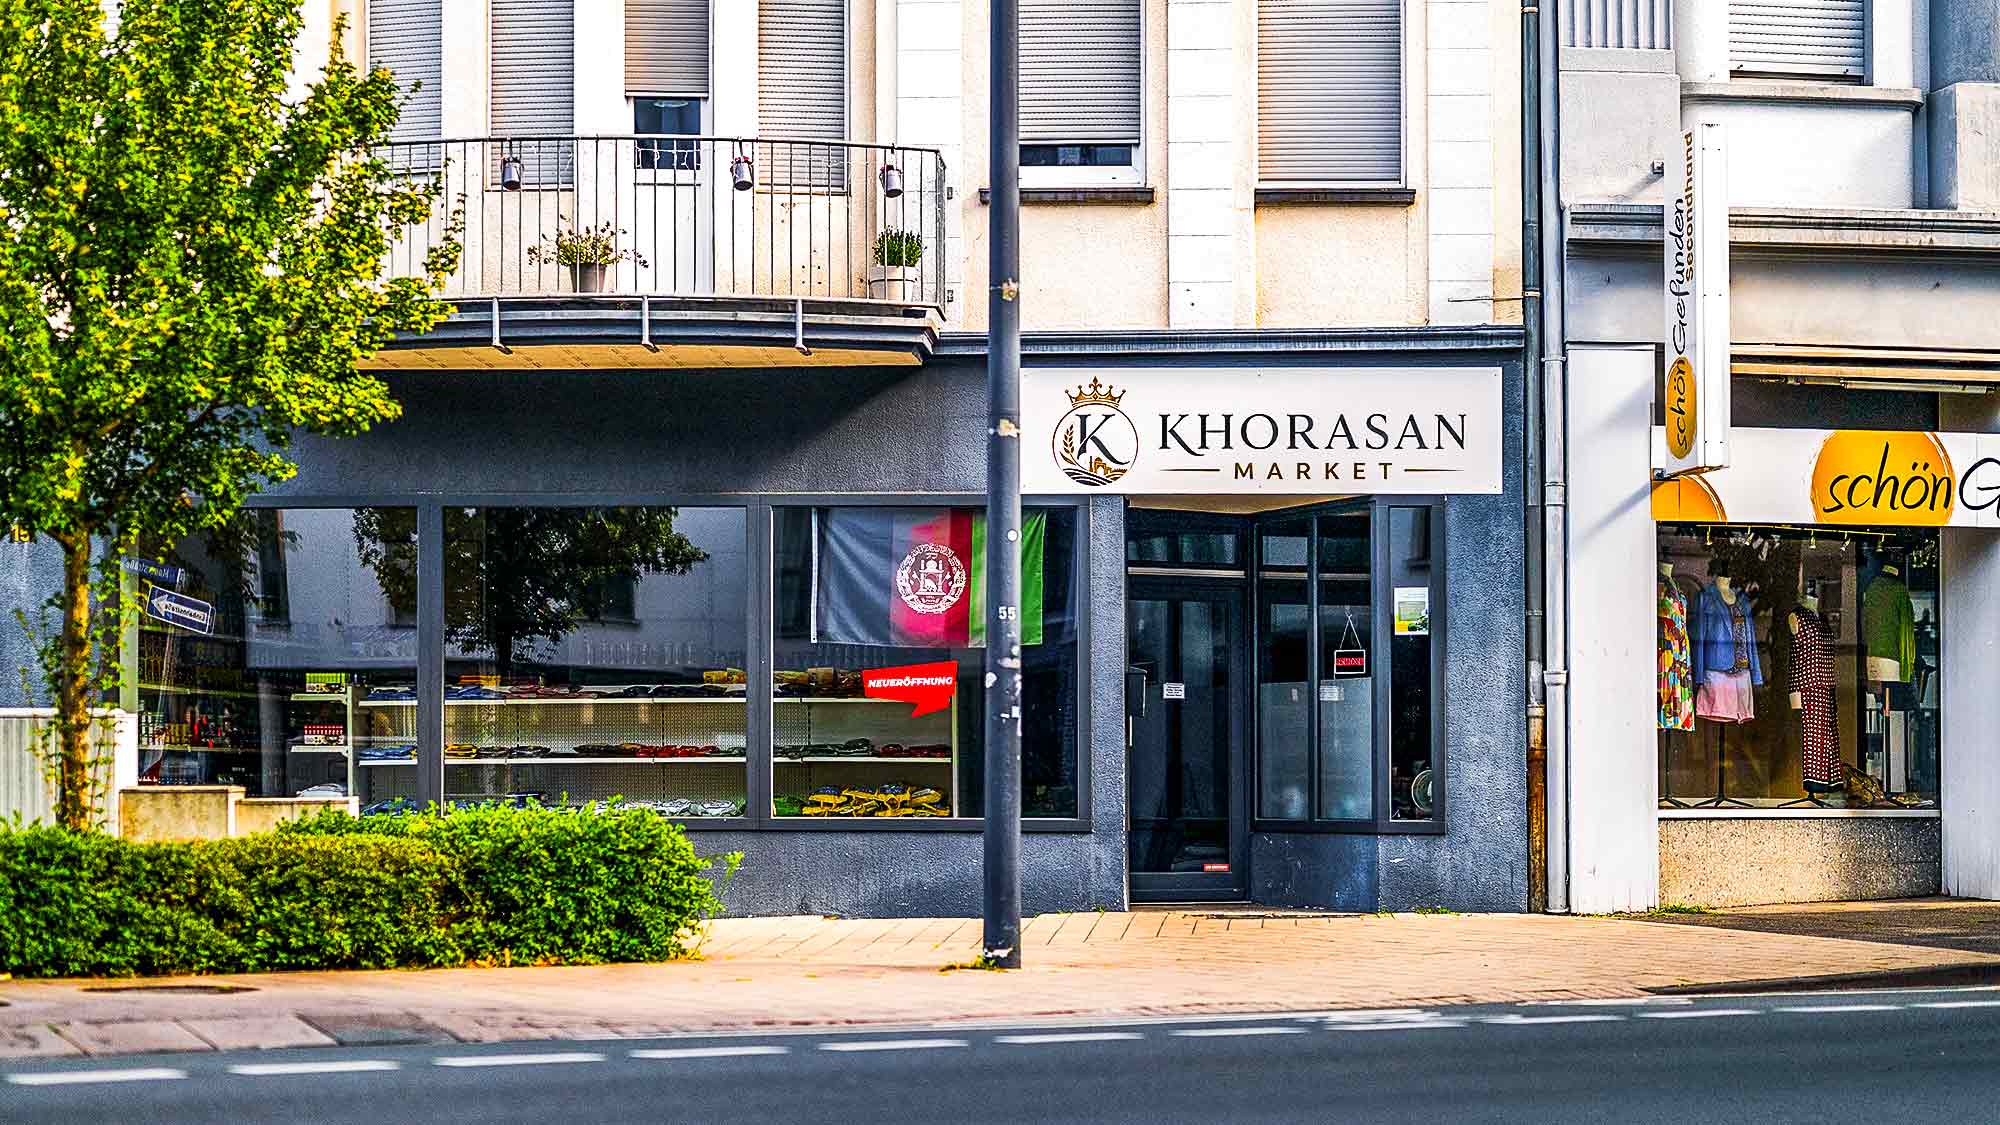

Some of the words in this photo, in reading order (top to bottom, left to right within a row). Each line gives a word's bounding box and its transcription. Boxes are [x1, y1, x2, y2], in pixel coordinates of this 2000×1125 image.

[1158, 413, 1467, 456] KHORASAN
[1233, 462, 1393, 480] MARKET
[998, 606, 1016, 620] 55
[868, 675, 954, 689] NEUERÖFFNUNG
